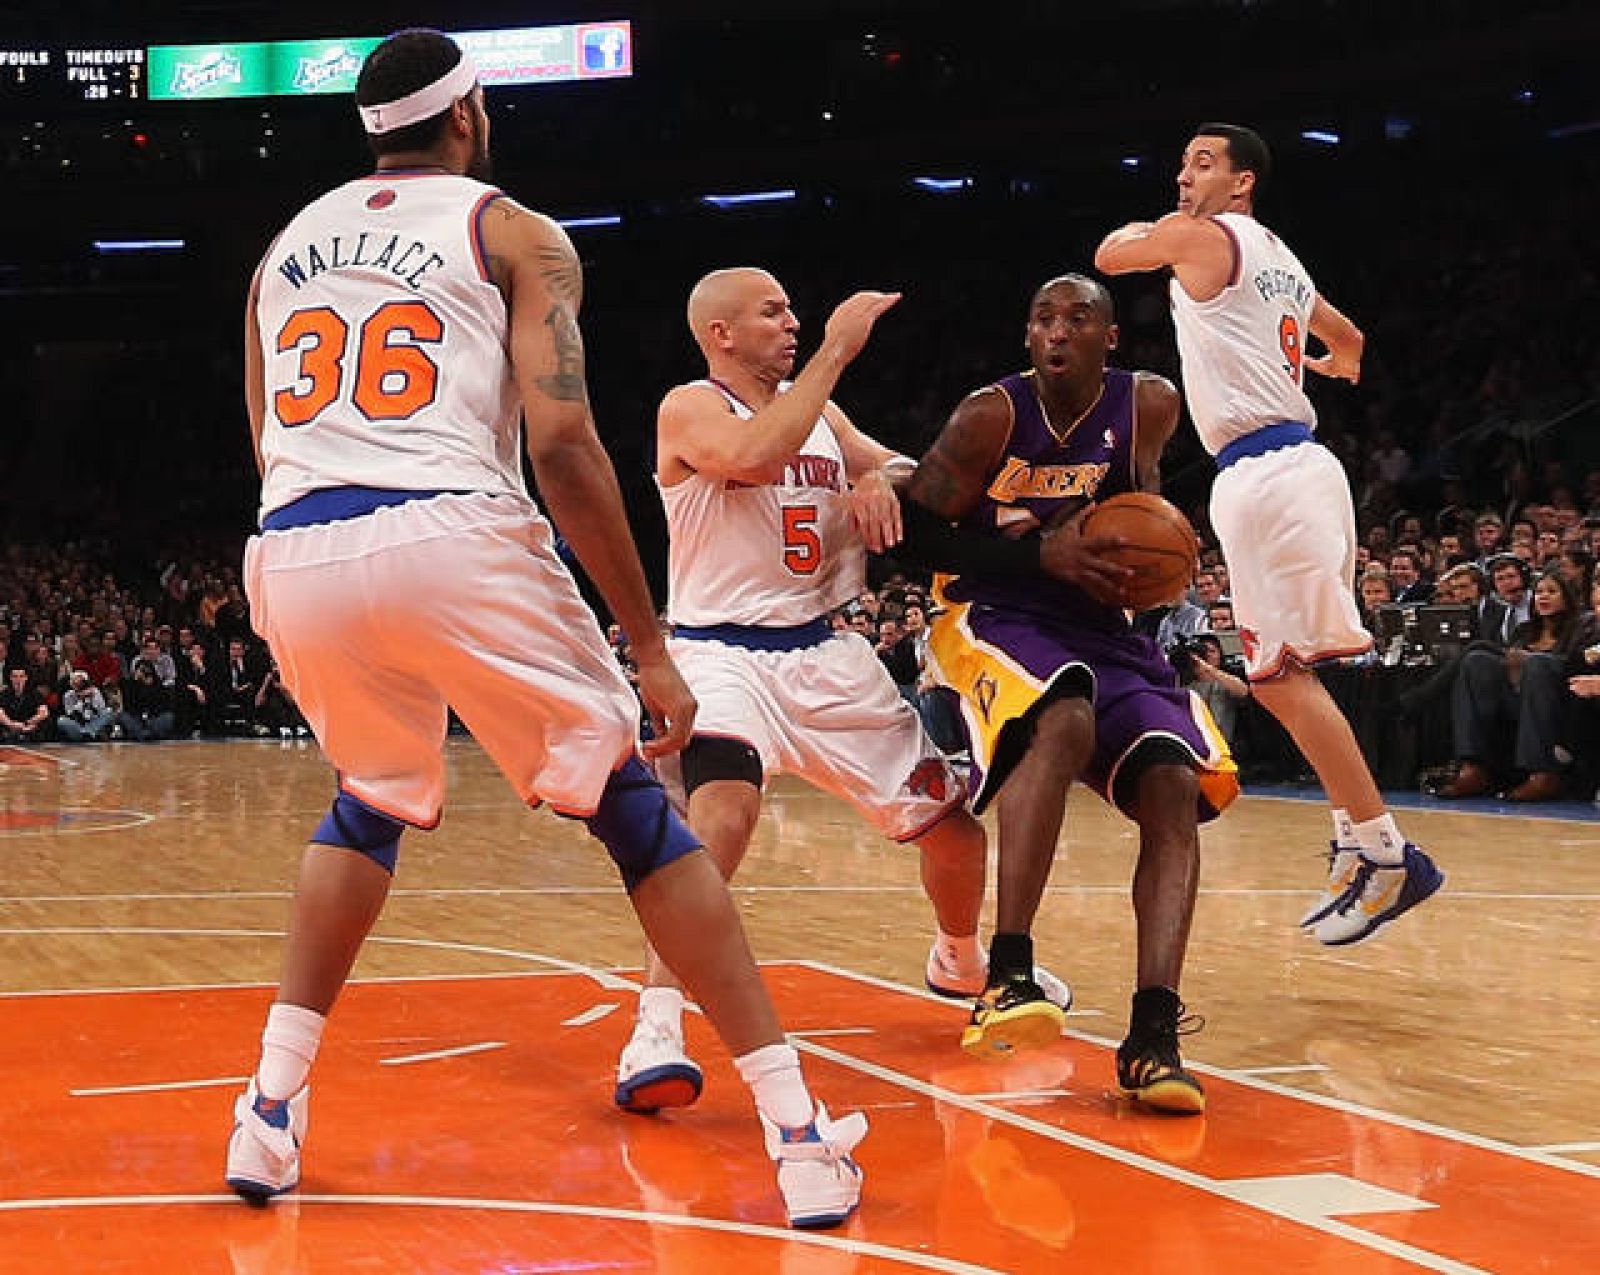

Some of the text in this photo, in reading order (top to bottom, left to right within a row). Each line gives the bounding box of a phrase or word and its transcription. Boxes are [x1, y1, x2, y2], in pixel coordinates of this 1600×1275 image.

[0, 52, 49, 65] FOULS
[66, 49, 144, 65] TIMEOUTS
[16, 66, 26, 82] 1
[67, 67, 108, 81] FULL
[129, 65, 140, 81] 3
[169, 52, 241, 97] Sprite
[129, 82, 139, 98] 1
[279, 232, 445, 290] WALLACE
[274, 299, 446, 428] 36
[1279, 313, 1302, 386] 9
[780, 504, 821, 576] 5
